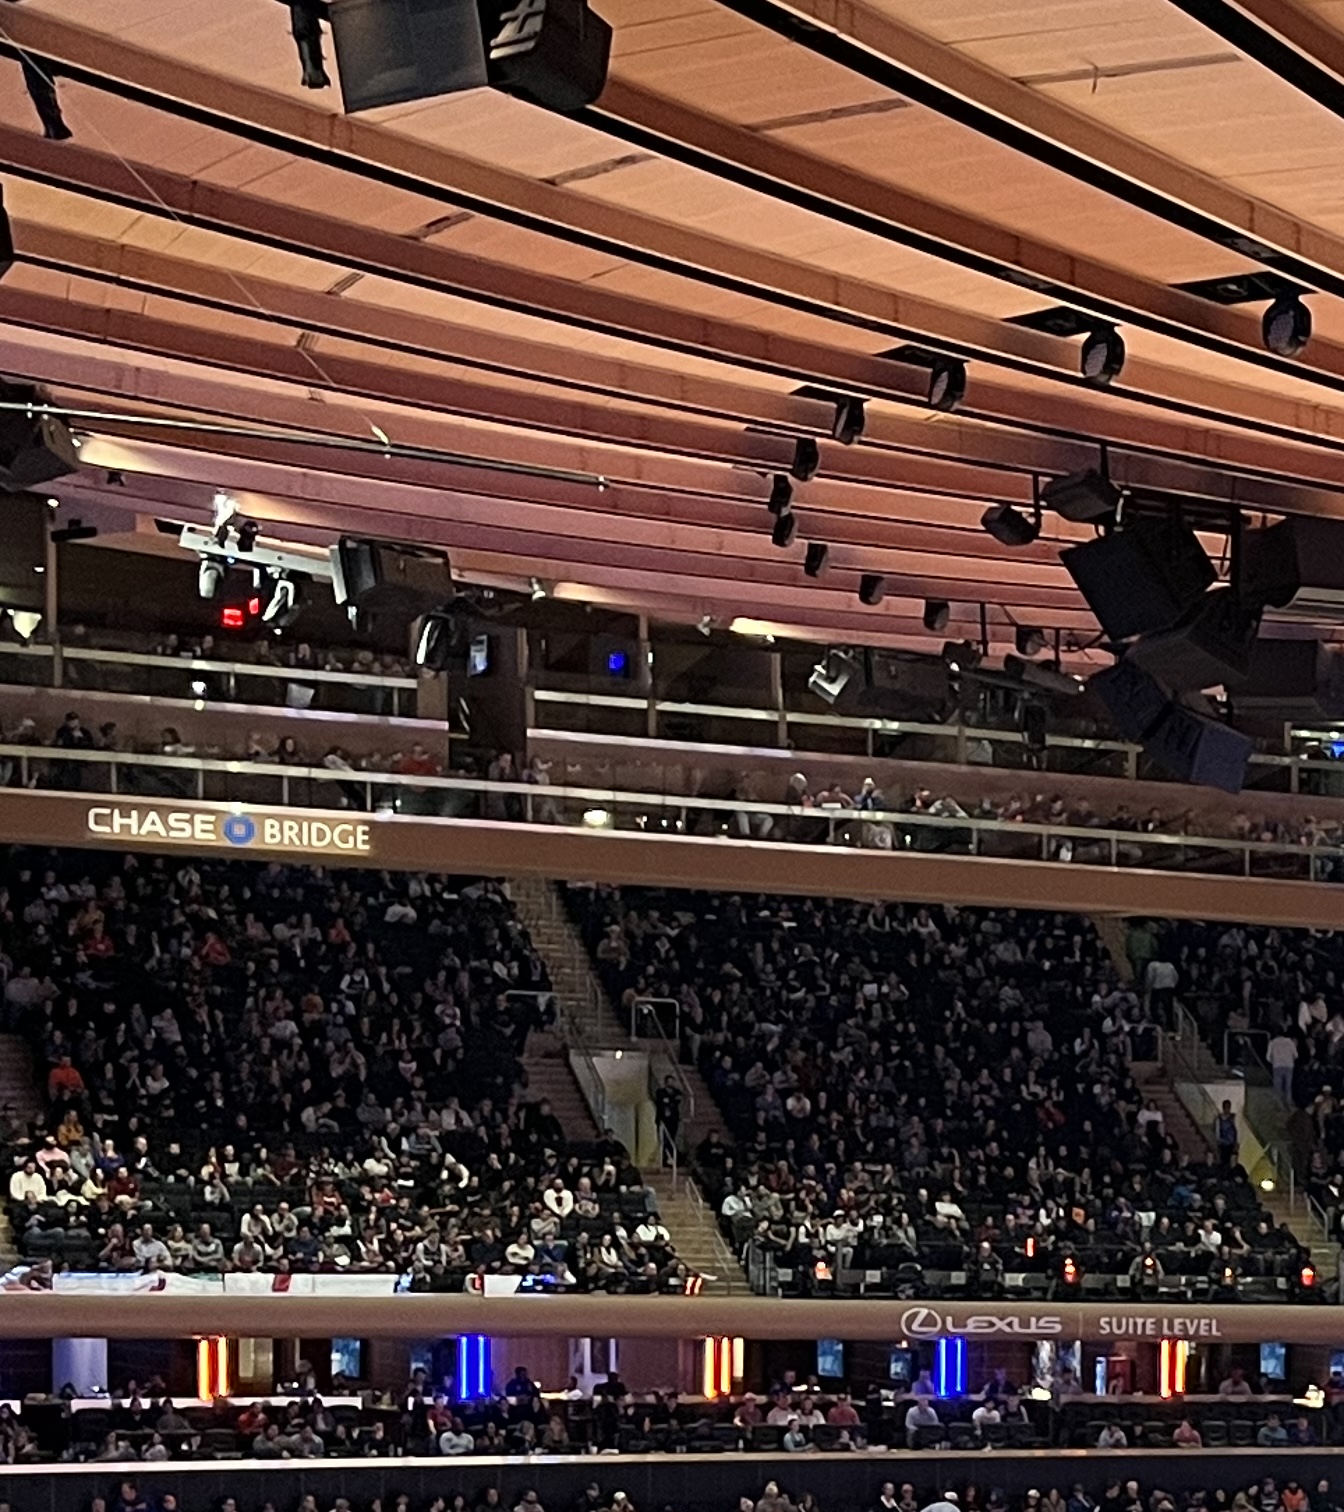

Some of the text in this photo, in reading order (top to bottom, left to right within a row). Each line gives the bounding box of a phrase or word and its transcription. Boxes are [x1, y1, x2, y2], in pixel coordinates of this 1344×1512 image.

[87, 806, 371, 850] CHASE BRIDGE
[945, 1315, 1222, 1337] LEXUS SUITE LEVEL
